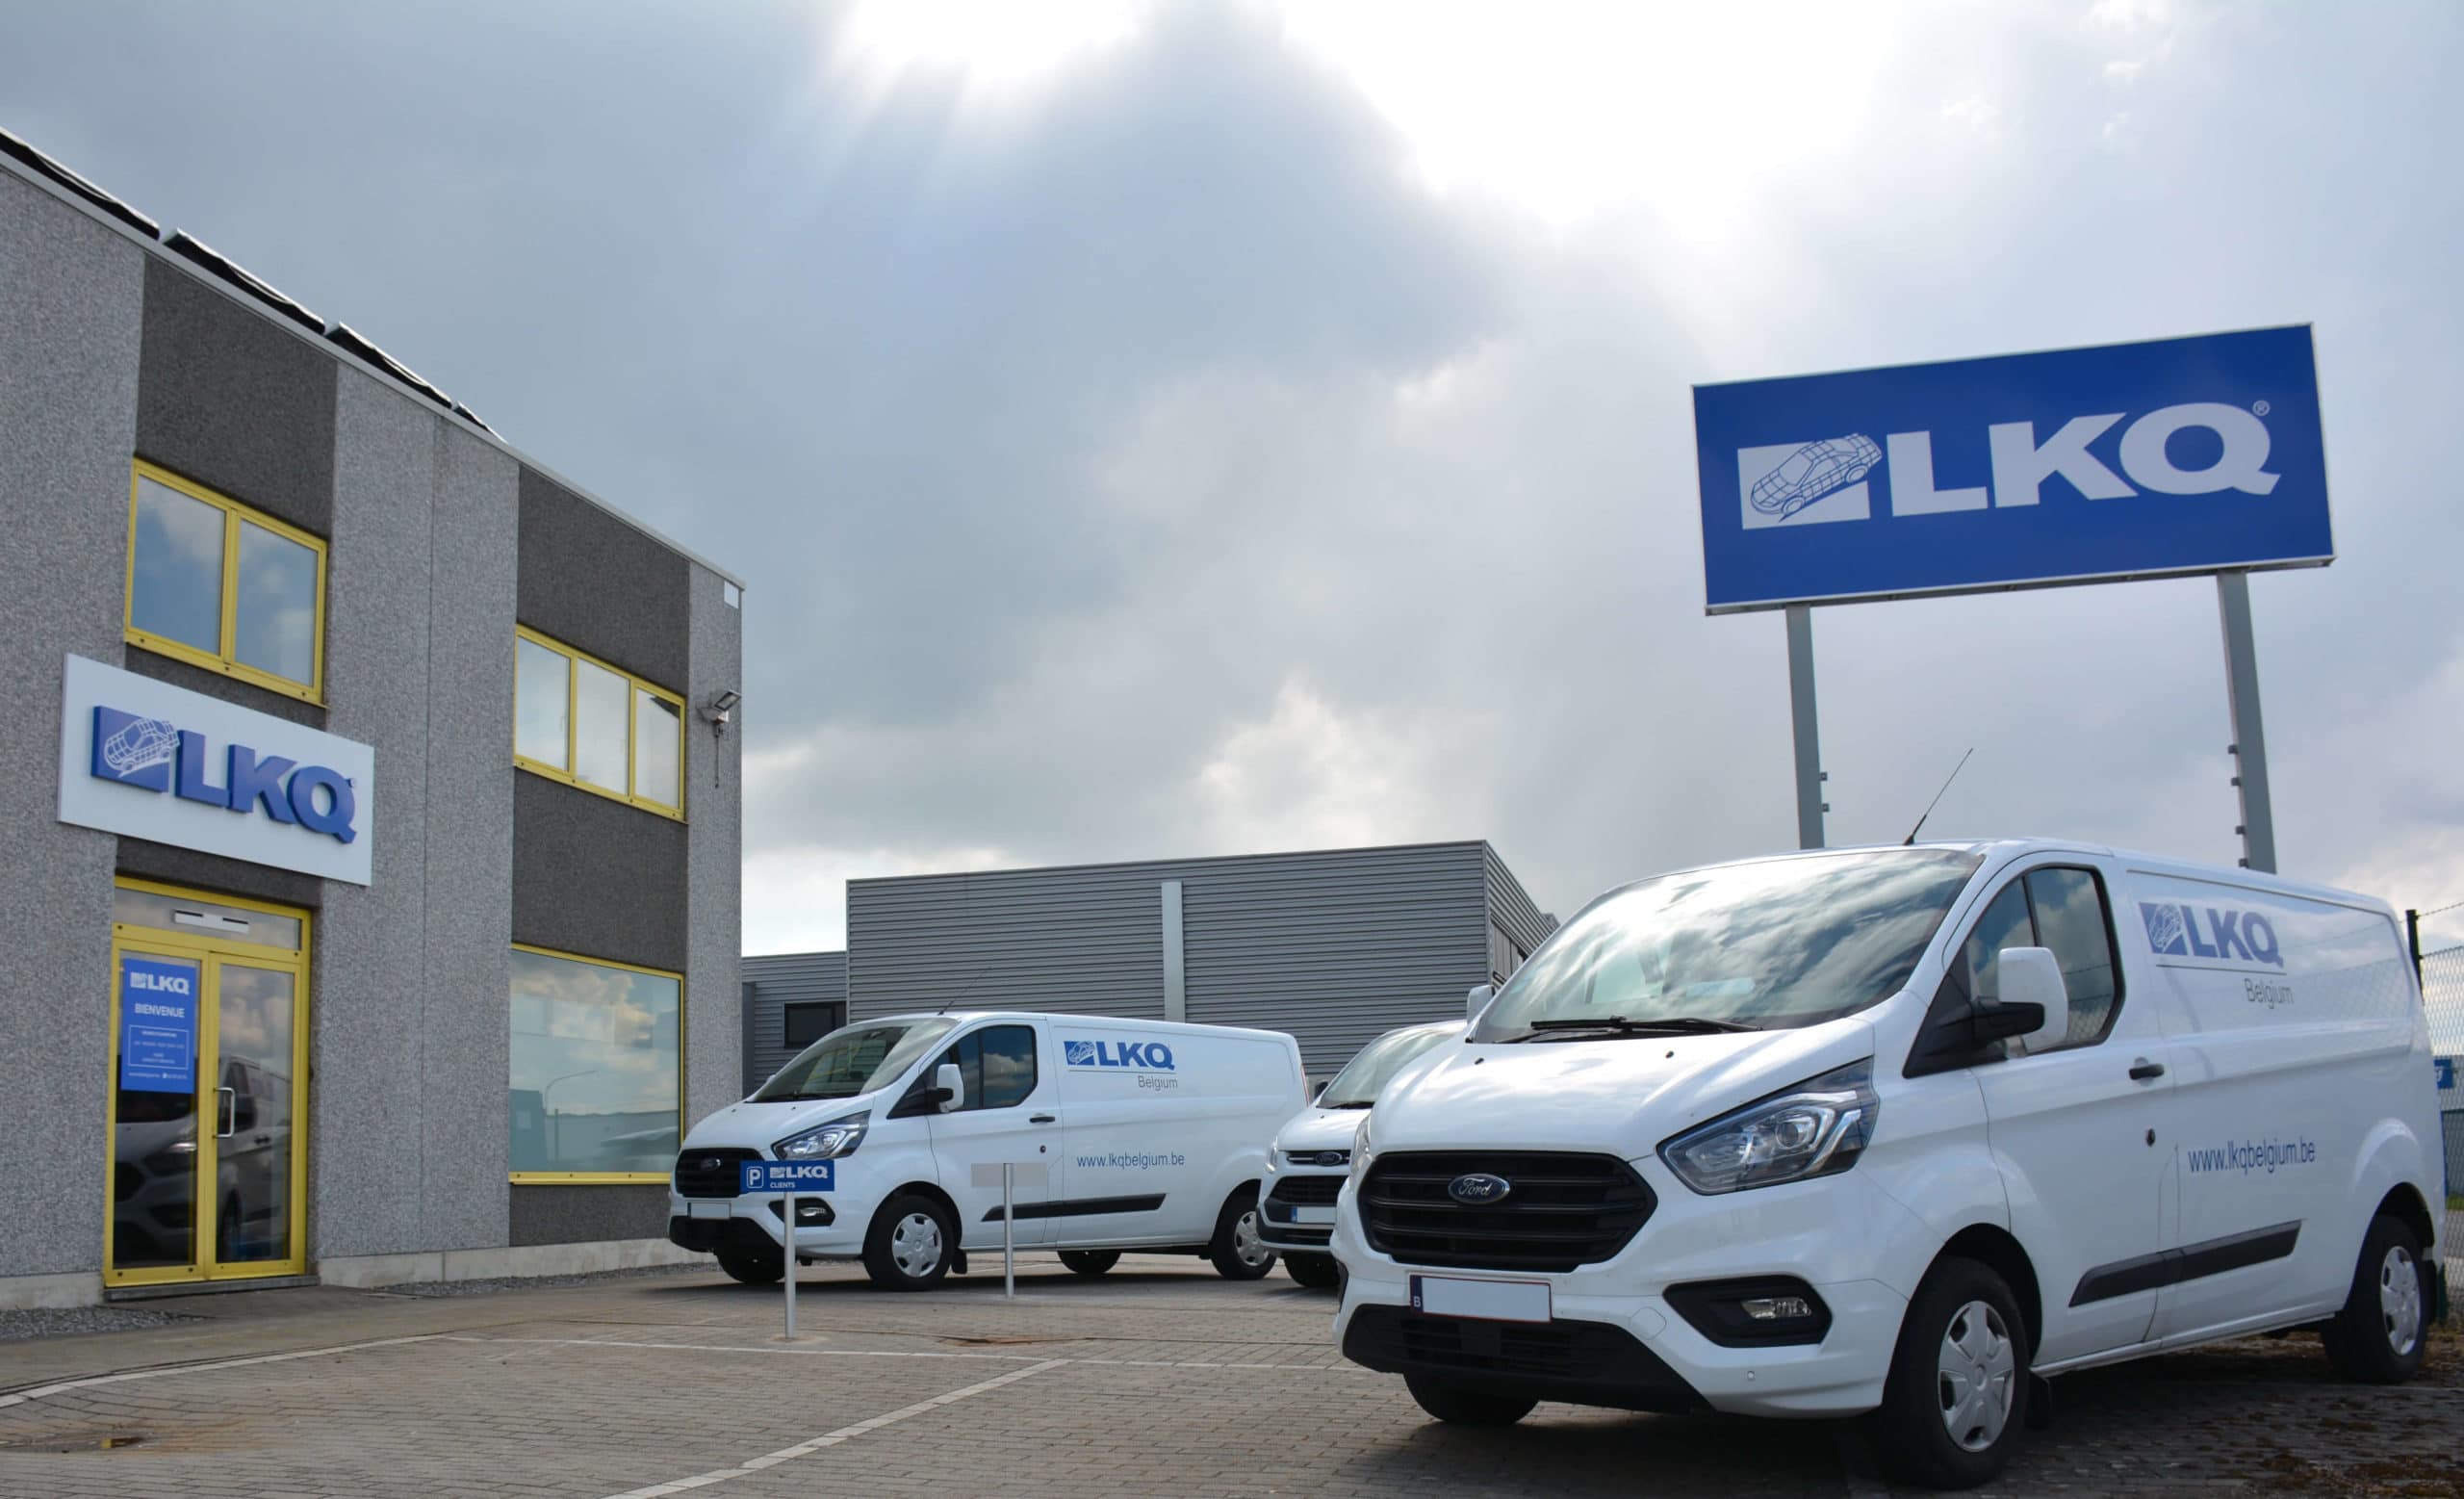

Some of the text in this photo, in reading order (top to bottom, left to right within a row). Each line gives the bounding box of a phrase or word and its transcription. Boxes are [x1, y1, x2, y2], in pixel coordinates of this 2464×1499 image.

[2180, 905, 2284, 969] LKQ
[147, 972, 190, 995] LKQ
[2245, 978, 2295, 1010] Belgium
[134, 1002, 185, 1019] BIENVENUE
[1095, 1041, 1175, 1071] LKQ
[1138, 1075, 1178, 1092] Belgium
[1077, 1150, 1185, 1170] www.lkqbelgium.be
[2188, 1135, 2316, 1175] www.lkqbelgium.be
[749, 1166, 829, 1186] P LKQ
[1458, 1177, 1494, 1196] Ford
